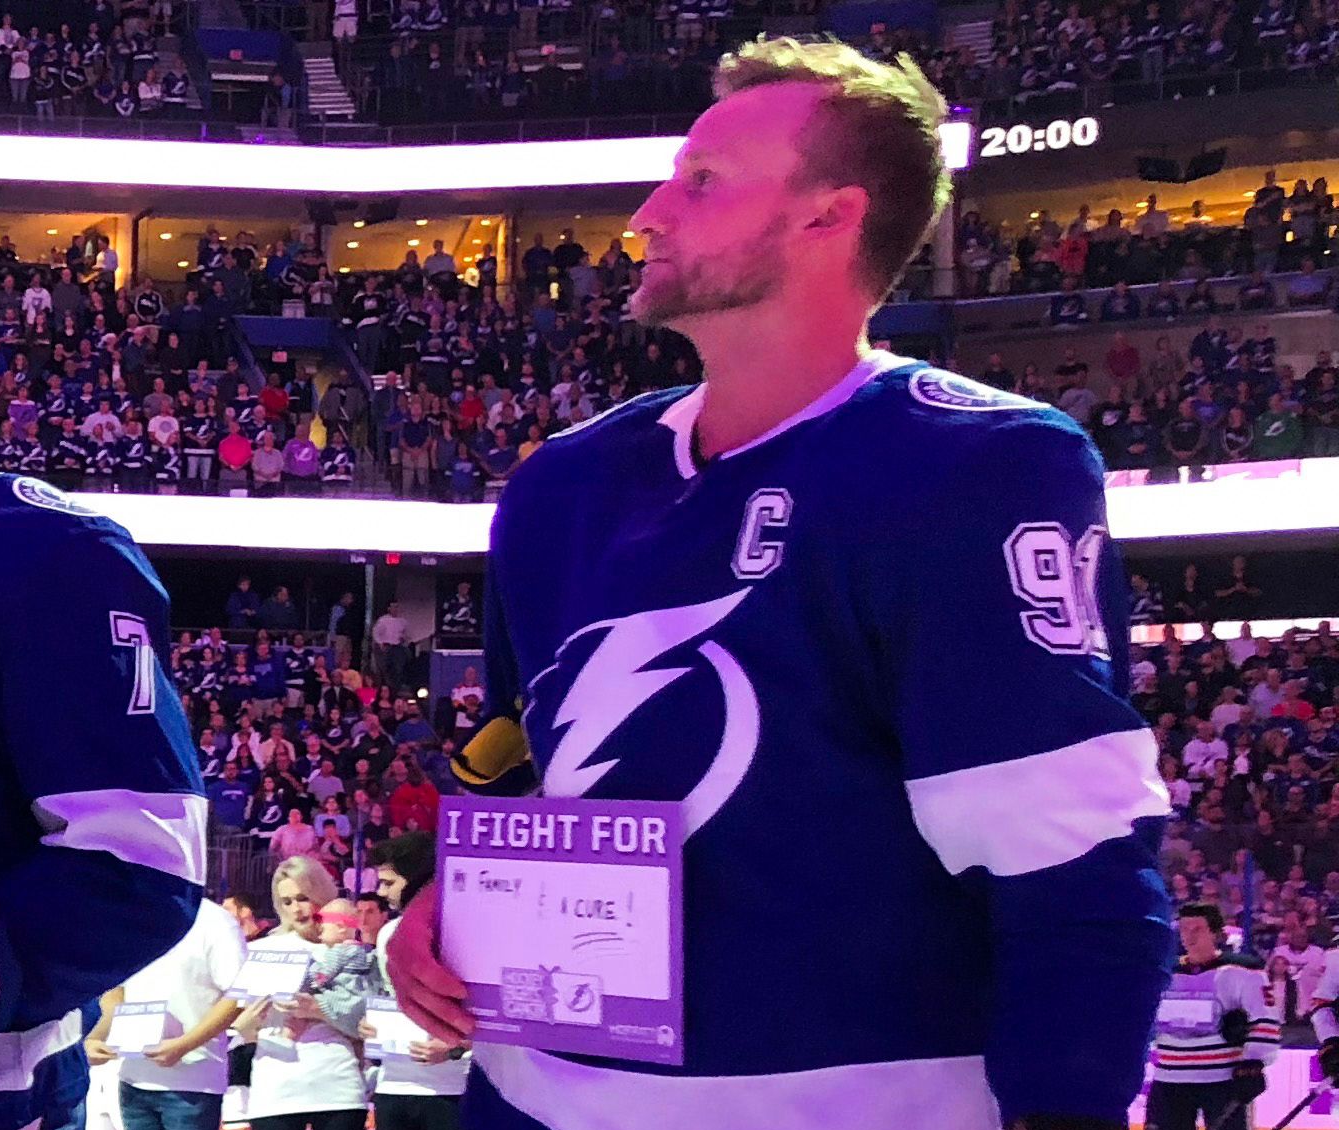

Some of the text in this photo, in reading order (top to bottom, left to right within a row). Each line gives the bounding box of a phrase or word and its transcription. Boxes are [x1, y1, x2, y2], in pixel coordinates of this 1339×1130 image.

[980, 116, 1099, 157] 20:00
[730, 486, 794, 579] C
[1003, 521, 1111, 660] 91
[444, 810, 667, 855] I FIGHT FOR
